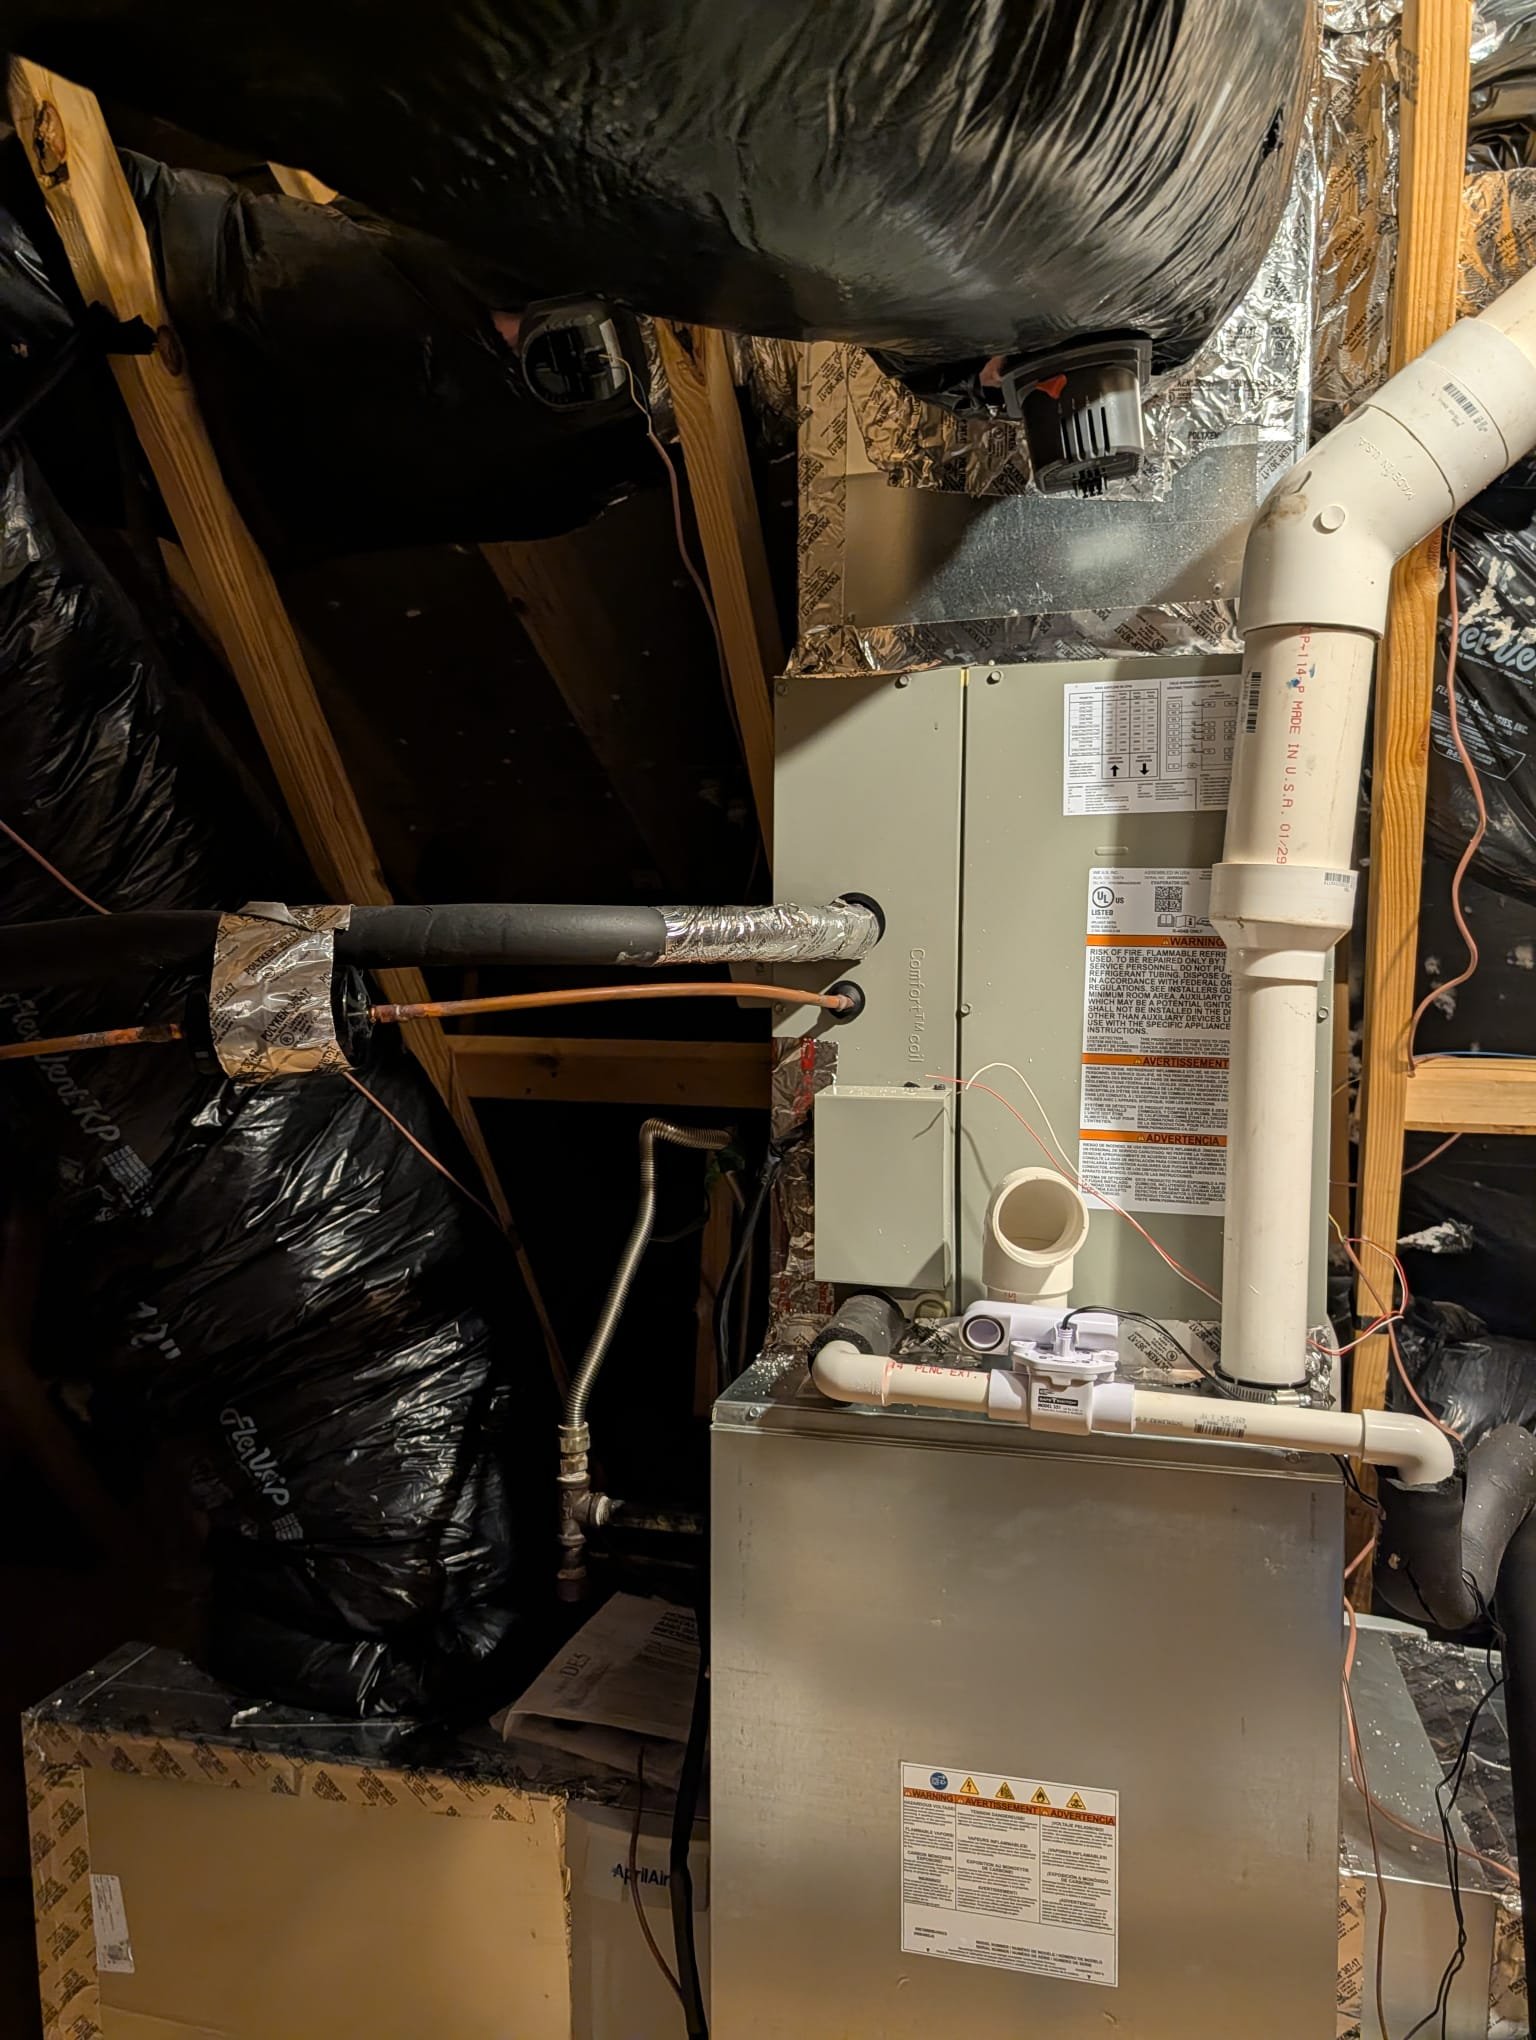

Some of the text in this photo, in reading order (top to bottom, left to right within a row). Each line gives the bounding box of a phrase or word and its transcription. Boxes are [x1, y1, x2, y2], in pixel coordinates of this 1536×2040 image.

[1289, 700, 1303, 734] MADE
[1287, 743, 1299, 760] IN
[1170, 937, 1226, 947] WARNING
[1147, 949, 1195, 957] FLAMMABLE
[1089, 970, 1147, 978] REFRIGERANT
[1180, 979, 1218, 987] FEDERAL
[1168, 986, 1218, 994] INSTALLERS
[1186, 1015, 1221, 1023] DEVICES
[1146, 1021, 1183, 1029] SPECIFIC
[1087, 1026, 1149, 1034] INSTRUCTIONS.
[1143, 1057, 1230, 1069] AVERTISSEMENT
[1146, 1134, 1220, 1145] ADVERTENCIA
[915, 1365, 943, 1375] PLNC
[912, 1790, 954, 1803] WARNING
[965, 1797, 1038, 1816] AVERTISSEMENT
[1051, 1808, 1116, 1826] ADVERTENCIA
